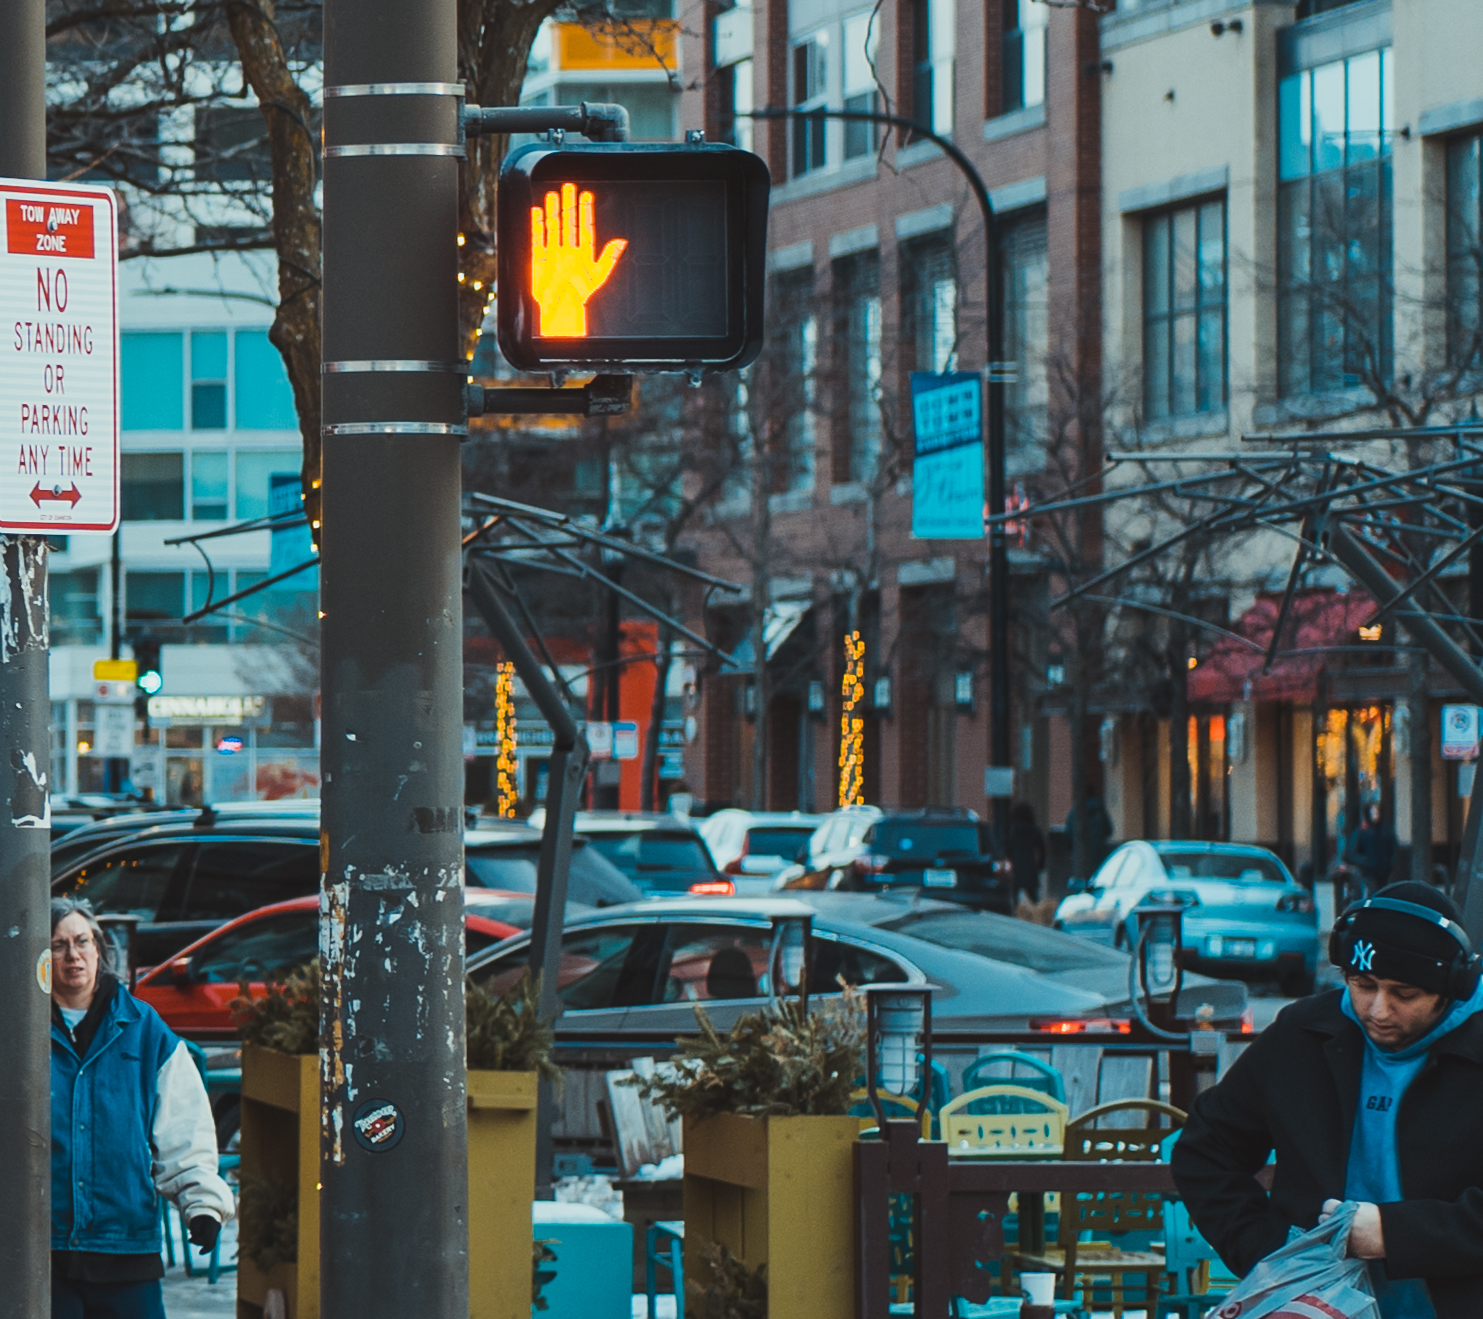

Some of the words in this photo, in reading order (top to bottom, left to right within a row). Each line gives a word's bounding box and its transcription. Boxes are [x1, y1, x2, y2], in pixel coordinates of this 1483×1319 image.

[20, 204, 44, 222] TOW
[47, 206, 80, 225] AWAY
[35, 234, 66, 253] ZONE
[36, 267, 69, 313] NO
[14, 322, 93, 355] STANDING
[44, 364, 65, 395] OR
[21, 403, 89, 436] PARKING
[18, 444, 50, 476] ANY
[59, 445, 94, 478] TIME
[370, 1123, 396, 1144] BAKERY
